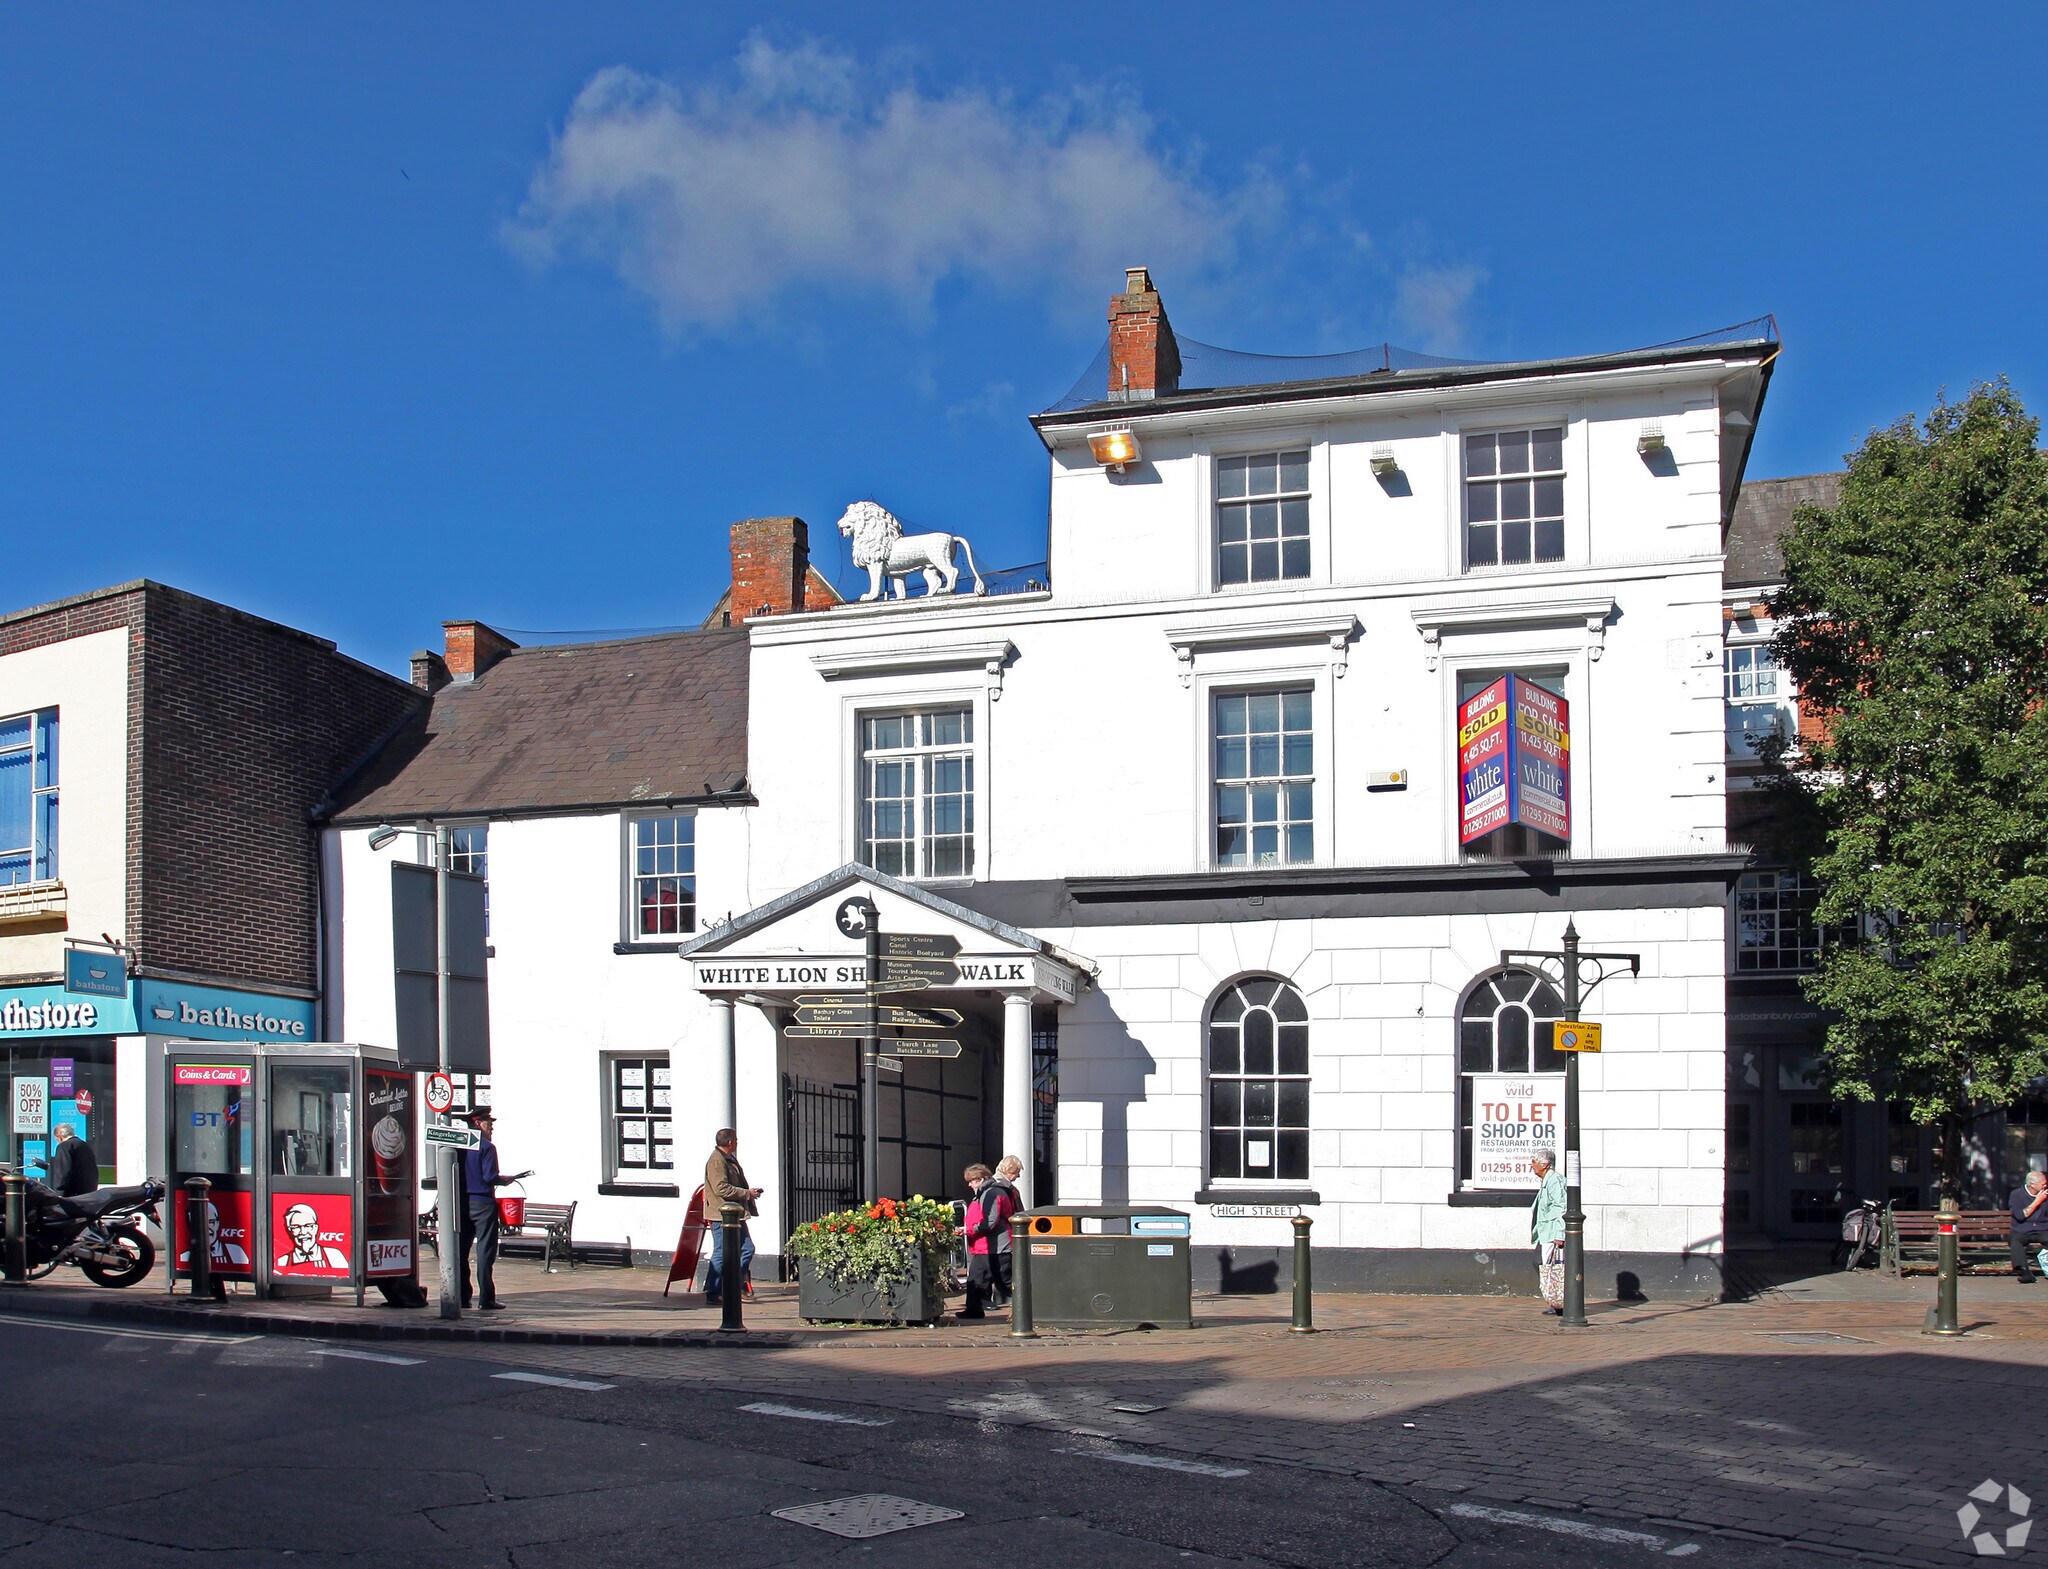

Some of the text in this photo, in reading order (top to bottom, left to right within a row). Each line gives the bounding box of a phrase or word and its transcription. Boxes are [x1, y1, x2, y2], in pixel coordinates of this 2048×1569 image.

[1467, 689, 1495, 718] BUILDING
[1525, 687, 1558, 714] BUILDING
[1464, 708, 1499, 740] SOLD
[1524, 716, 1562, 743] SOLD
[1520, 731, 1541, 750] 11,425
[1463, 743, 1479, 764] 11,425
[1466, 763, 1501, 800] white
[1523, 760, 1563, 797] white
[1463, 804, 1507, 836] 01295 271000
[1520, 804, 1567, 832] 01295 271000
[699, 964, 1025, 984] WHITE LION SH WALK
[76, 980, 120, 993] bathstore
[0, 998, 98, 1031] thstore
[180, 1000, 306, 1037] bathstore
[809, 1027, 843, 1036] Library
[179, 1069, 237, 1080] Coins & Cards
[20, 1083, 42, 1098] 50%
[369, 1088, 408, 1106] Caramel Latte
[1506, 1084, 1534, 1096] wild
[20, 1098, 42, 1113] OFF
[389, 1102, 404, 1113] DELUXE
[1482, 1102, 1556, 1122] TO LET
[18, 1116, 43, 1124] 25% OFF
[191, 1112, 220, 1127] BT
[1481, 1123, 1556, 1138] SHOP OR
[1532, 1140, 1556, 1148] SPACE
[1480, 1162, 1512, 1173] 01295
[1217, 1206, 1294, 1216] HIGH STREET
[221, 1228, 246, 1238] KFC
[318, 1232, 345, 1242] KFC
[384, 1244, 408, 1259] KFC
